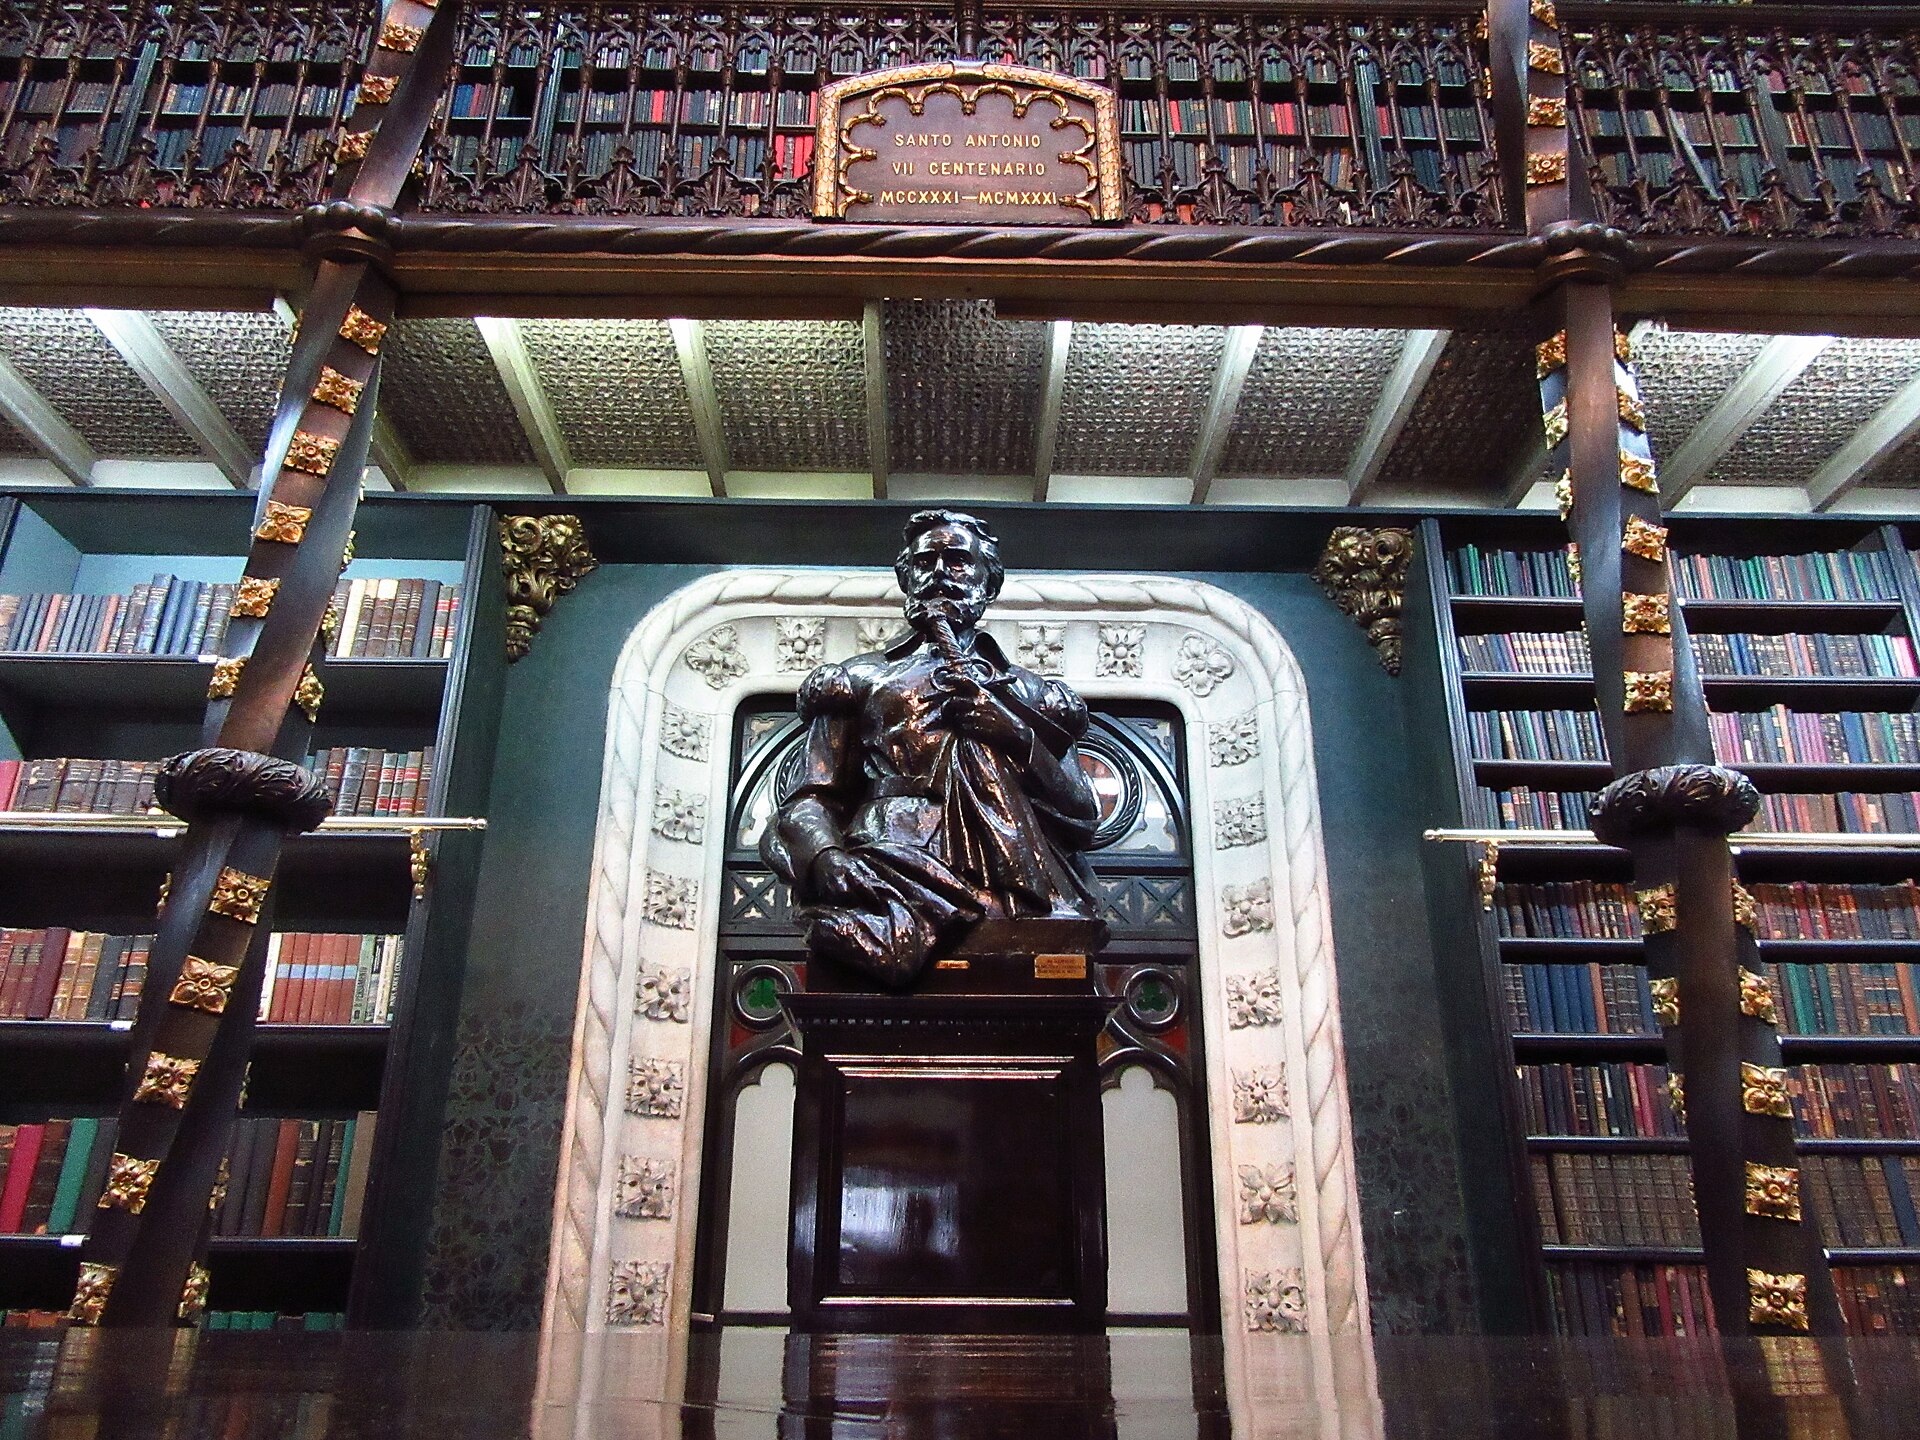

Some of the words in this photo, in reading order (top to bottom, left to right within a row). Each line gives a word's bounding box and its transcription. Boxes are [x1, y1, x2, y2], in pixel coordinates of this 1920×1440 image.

[895, 134, 952, 147] SANTO
[965, 134, 1041, 147] ANTONIO
[892, 162, 914, 175] VII
[929, 162, 1045, 176] CENTENARIO
